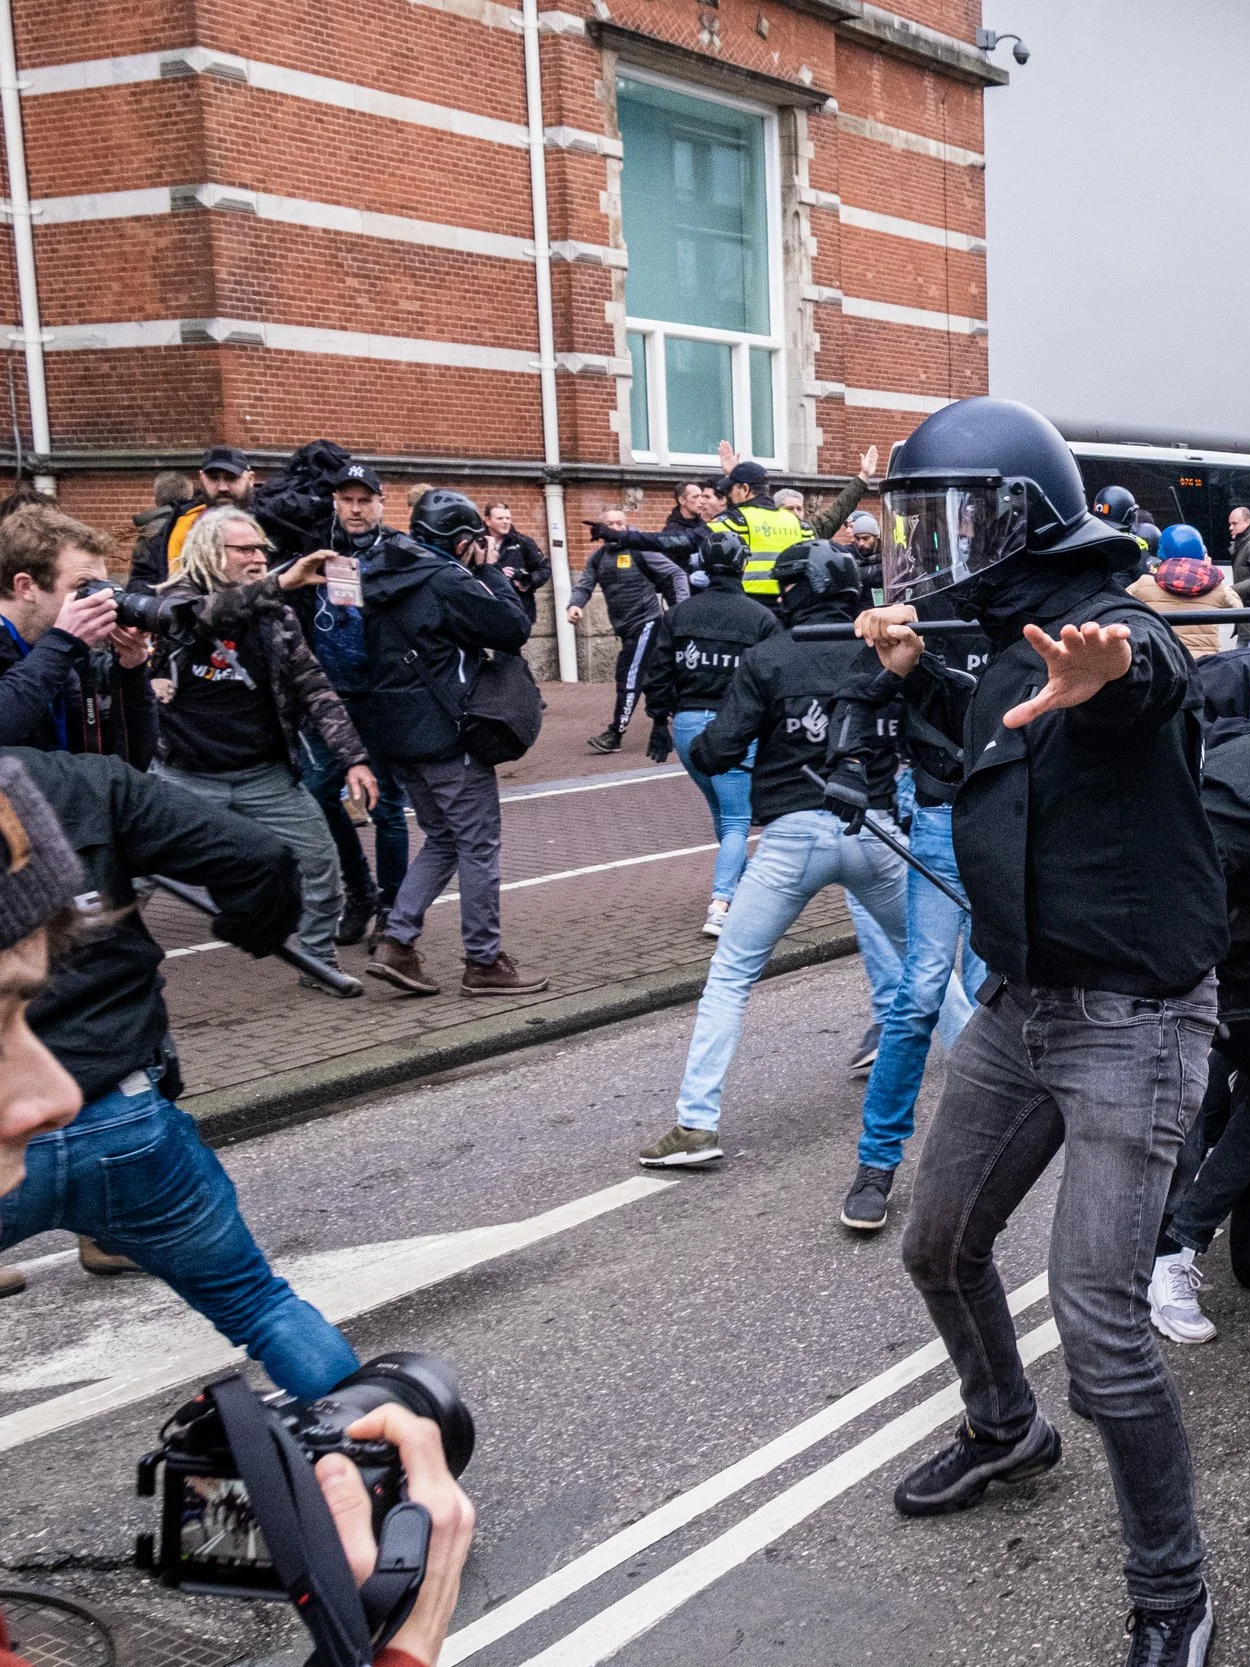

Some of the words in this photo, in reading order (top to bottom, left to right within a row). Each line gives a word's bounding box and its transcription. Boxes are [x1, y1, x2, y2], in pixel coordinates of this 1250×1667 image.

[755, 524, 798, 537] POLITIE
[675, 647, 740, 670] POLITI
[618, 691, 636, 733] adidas
[786, 711, 899, 743] POIE
